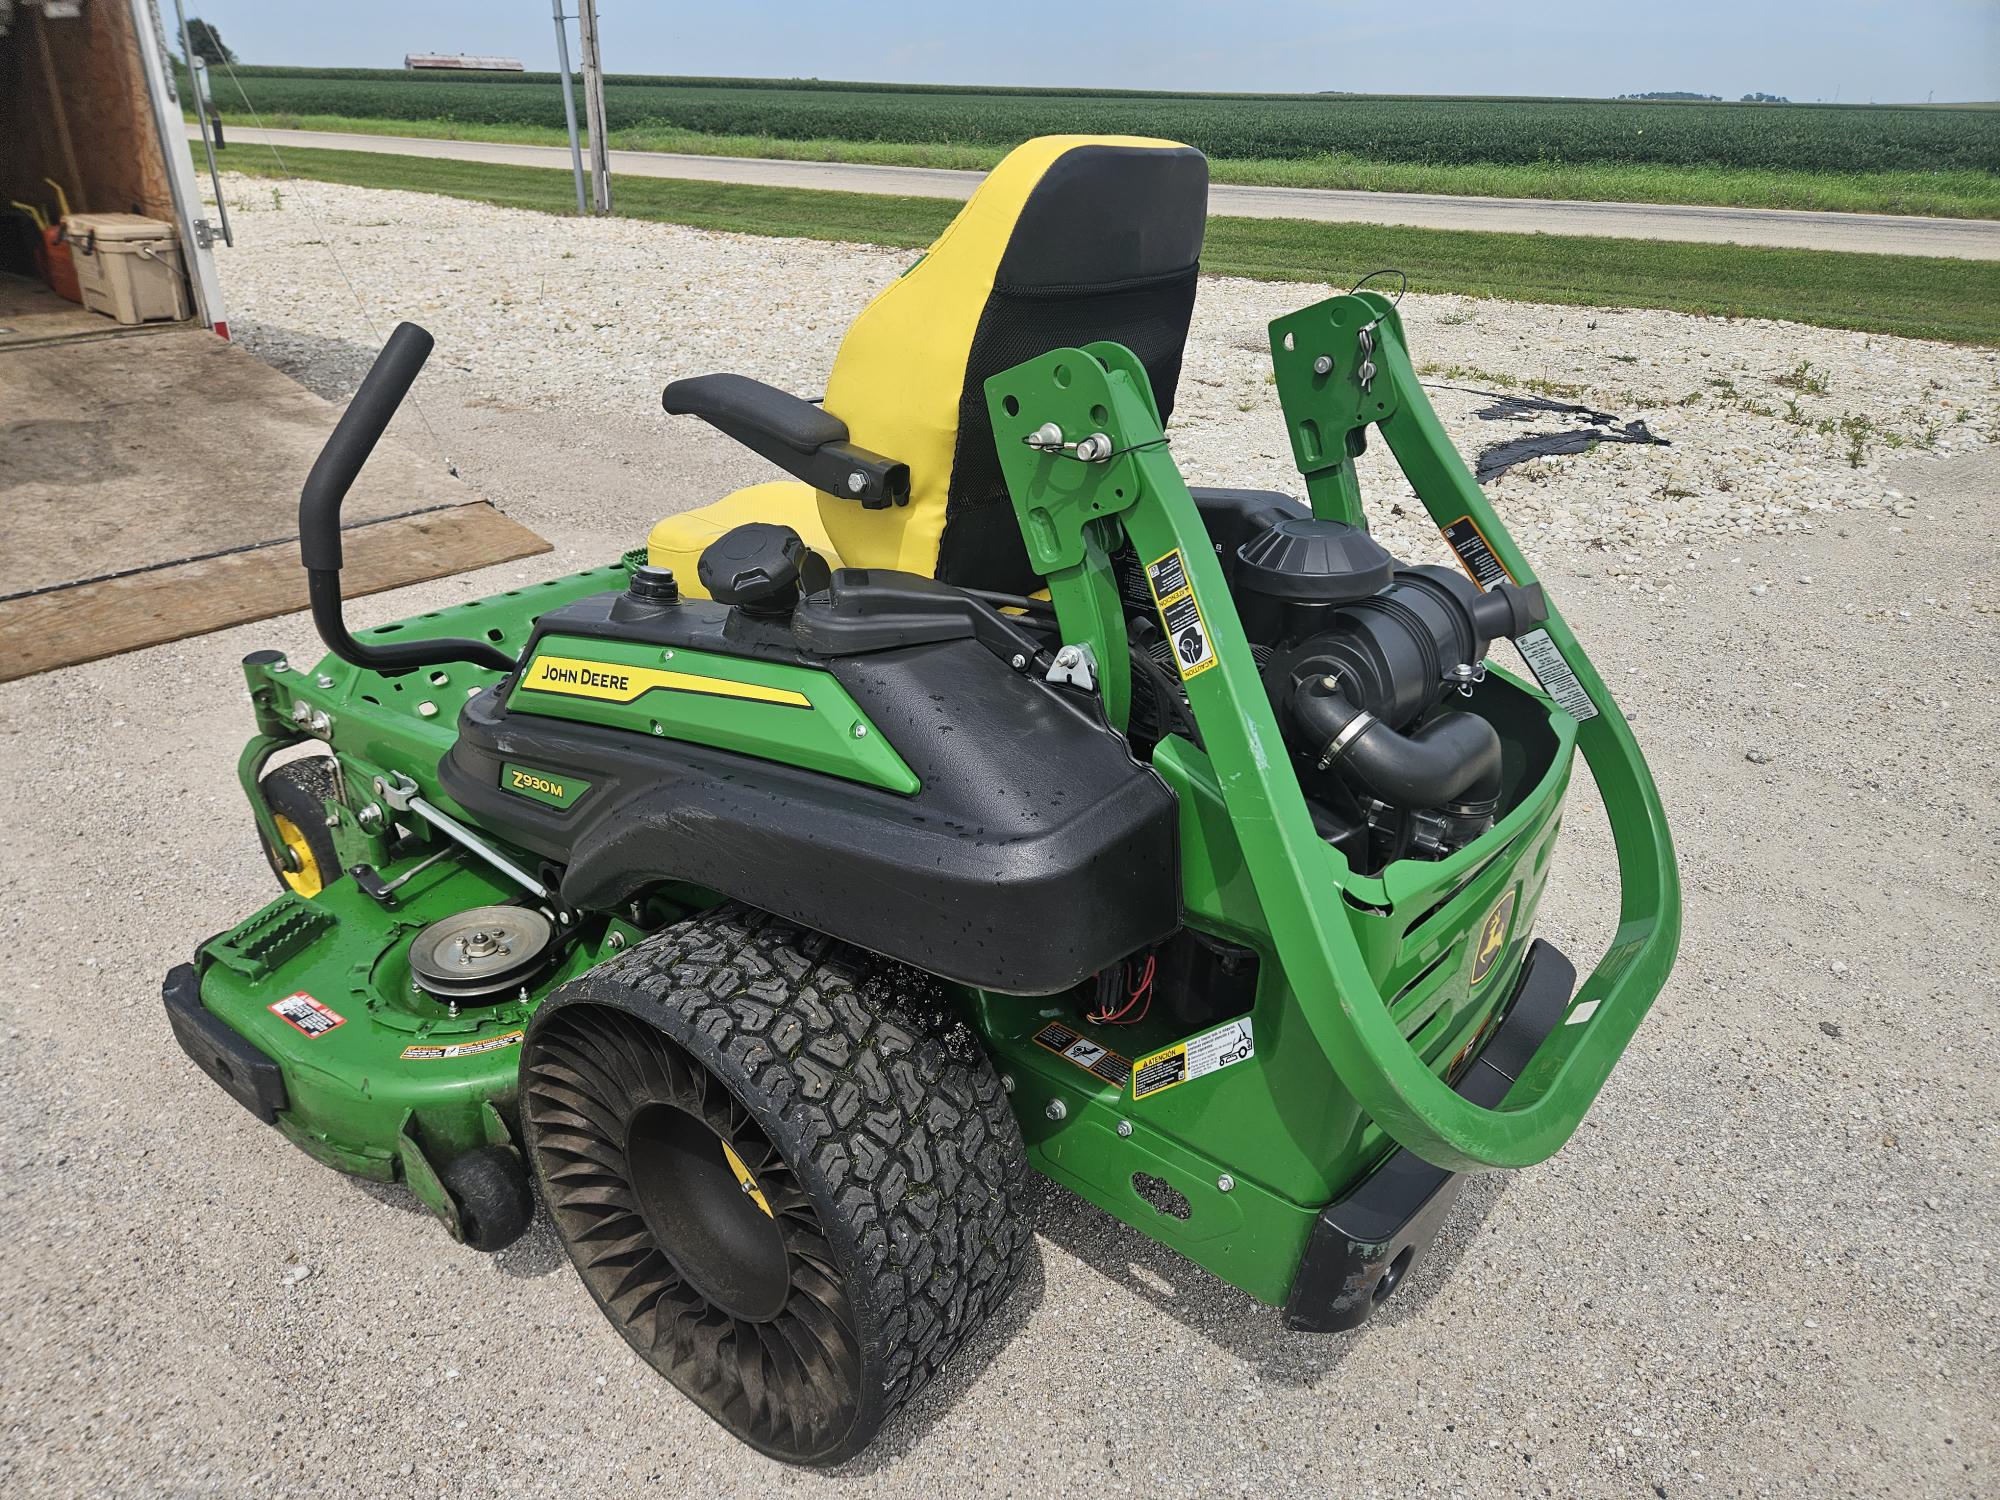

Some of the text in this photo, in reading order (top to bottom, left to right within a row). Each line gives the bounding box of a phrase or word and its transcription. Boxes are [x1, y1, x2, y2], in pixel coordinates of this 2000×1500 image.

[541, 664, 629, 691] JOHN DEERE
[1184, 661, 1210, 677] CAUTION
[511, 770, 563, 798] Z930M
